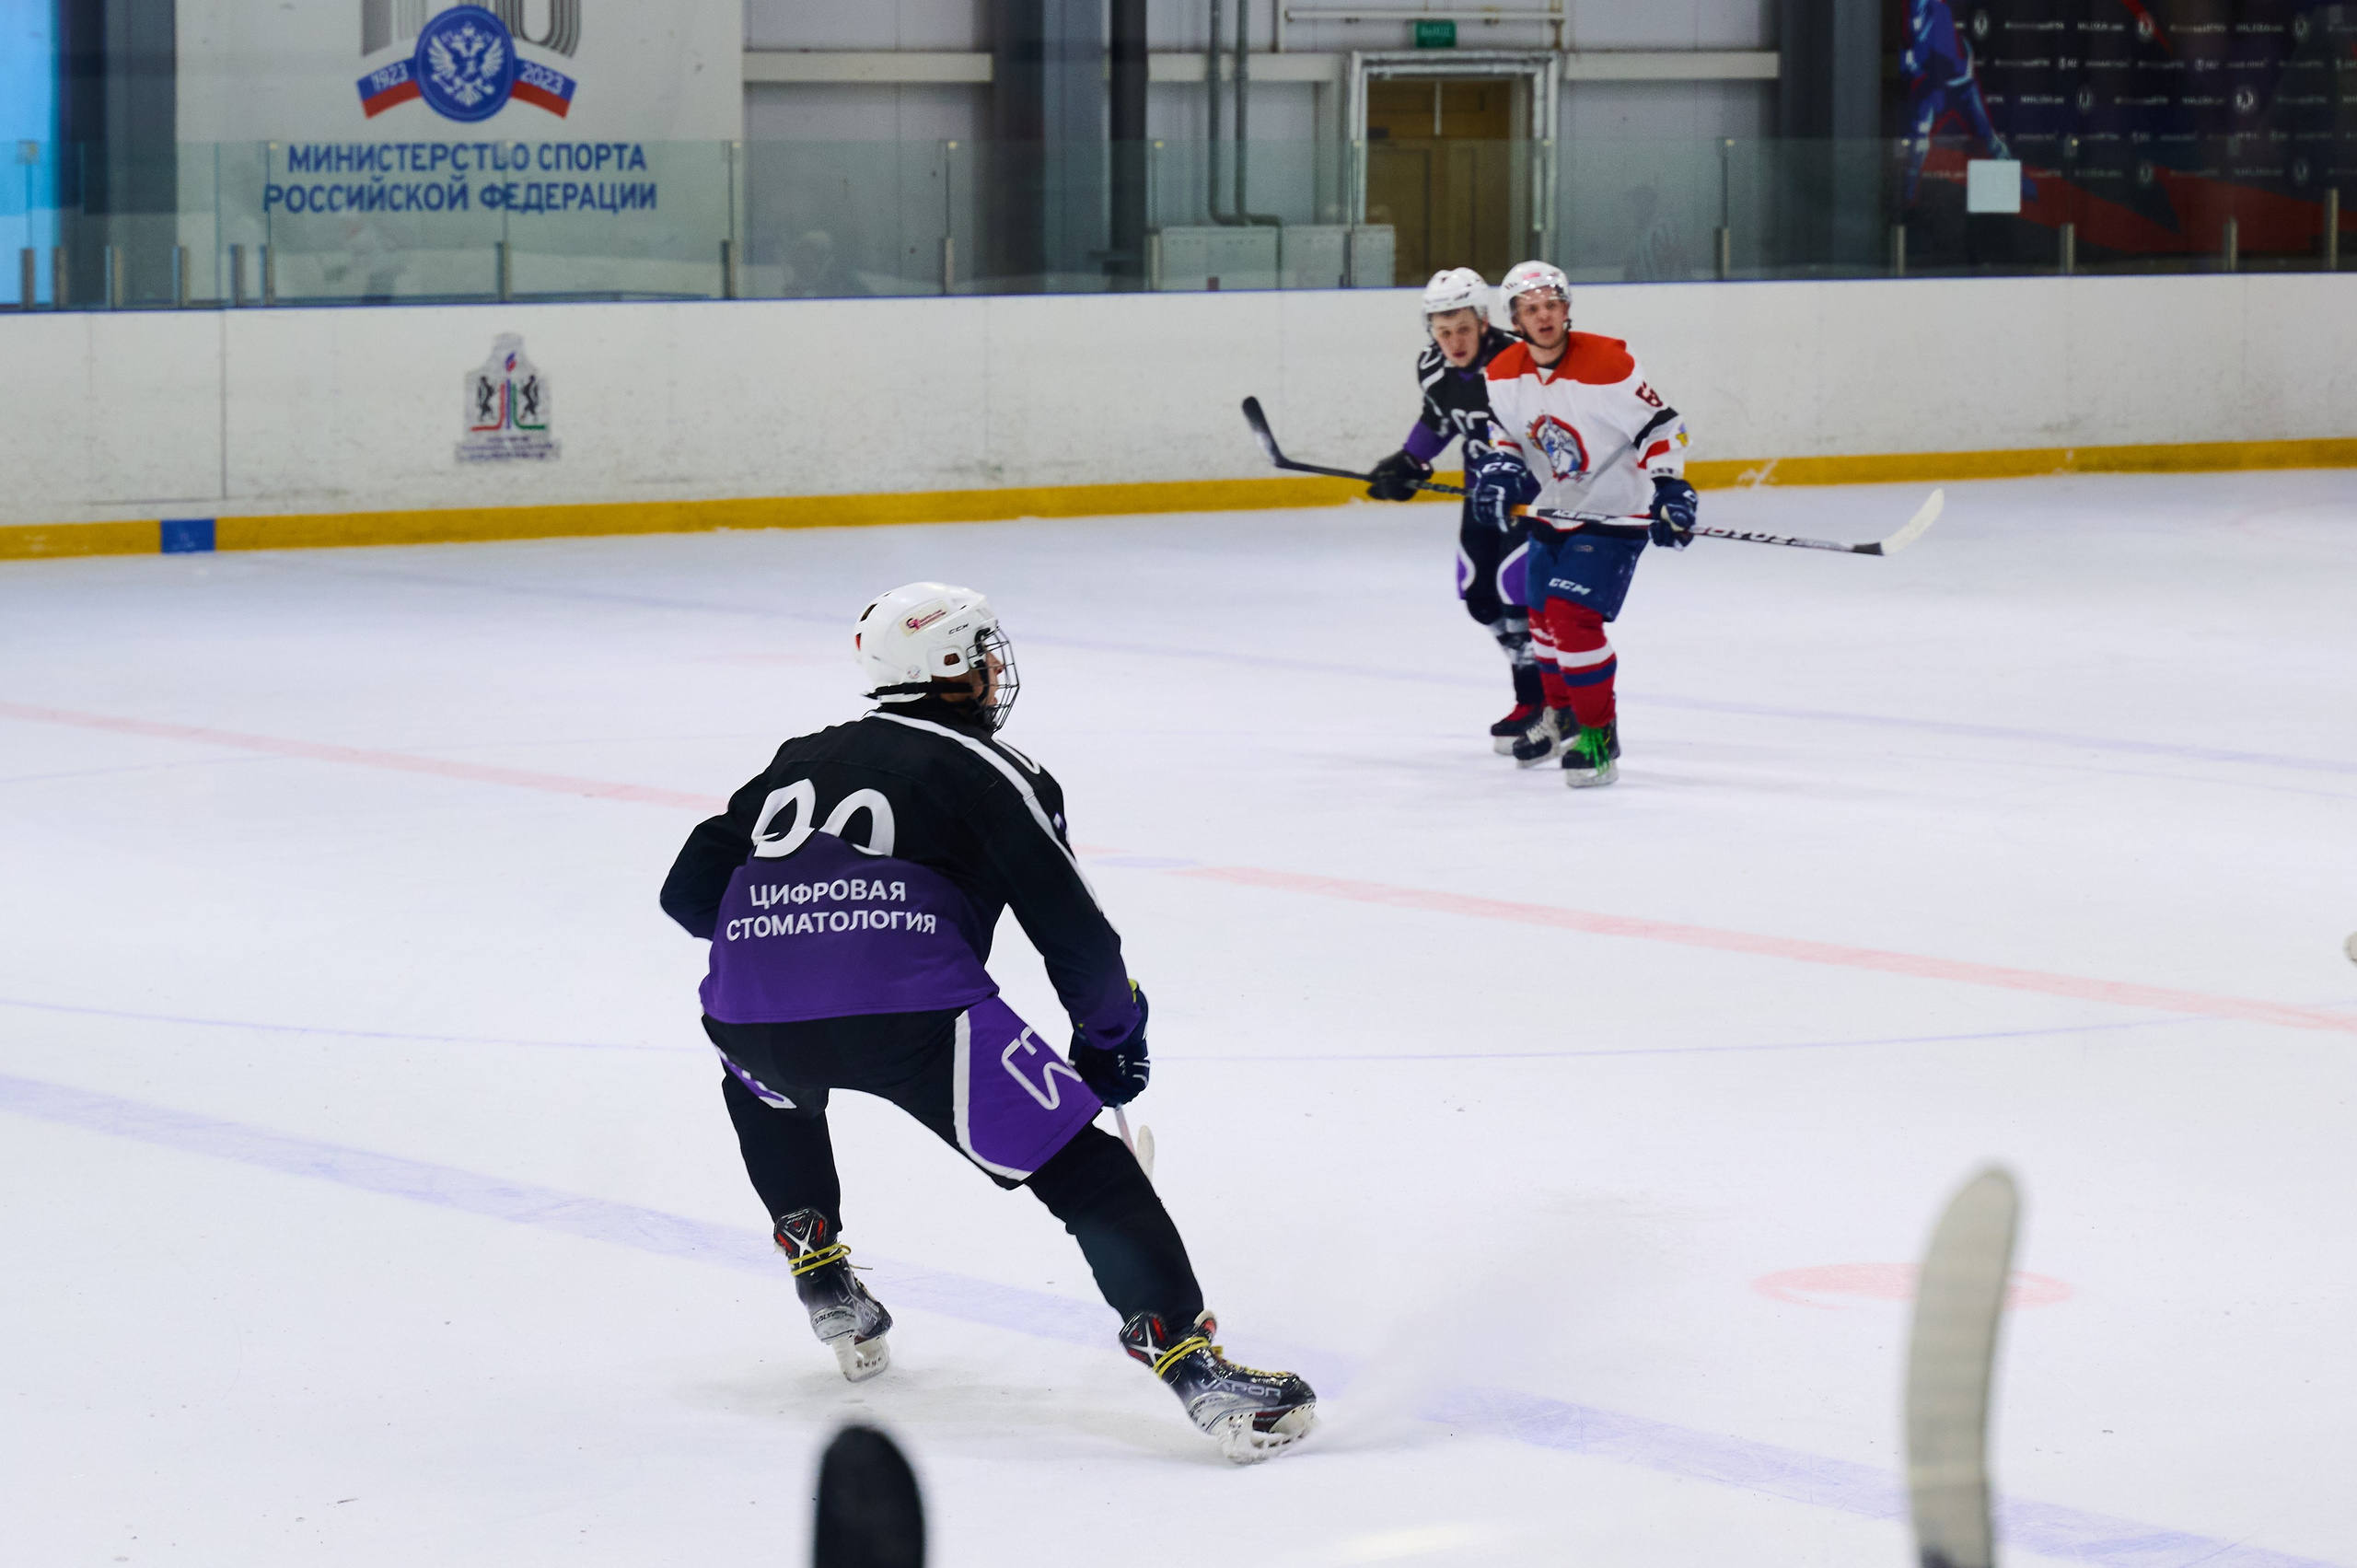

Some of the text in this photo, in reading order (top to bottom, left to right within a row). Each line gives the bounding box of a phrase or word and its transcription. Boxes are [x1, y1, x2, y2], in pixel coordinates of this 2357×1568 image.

[371, 62, 409, 91] 1923
[519, 62, 564, 95] 2023
[538, 142, 648, 172] СПОРТА
[263, 175, 657, 215] РОССИЙСКОЙ ФЕДЕРАЦИИ
[1548, 576, 1593, 597] CCM
[948, 622, 970, 635] CCM
[749, 878, 907, 911] ЦИФРОВАЯ
[726, 910, 937, 942] СТОМАТОЛОГИЯ
[1199, 1378, 1282, 1399] VAPOR
